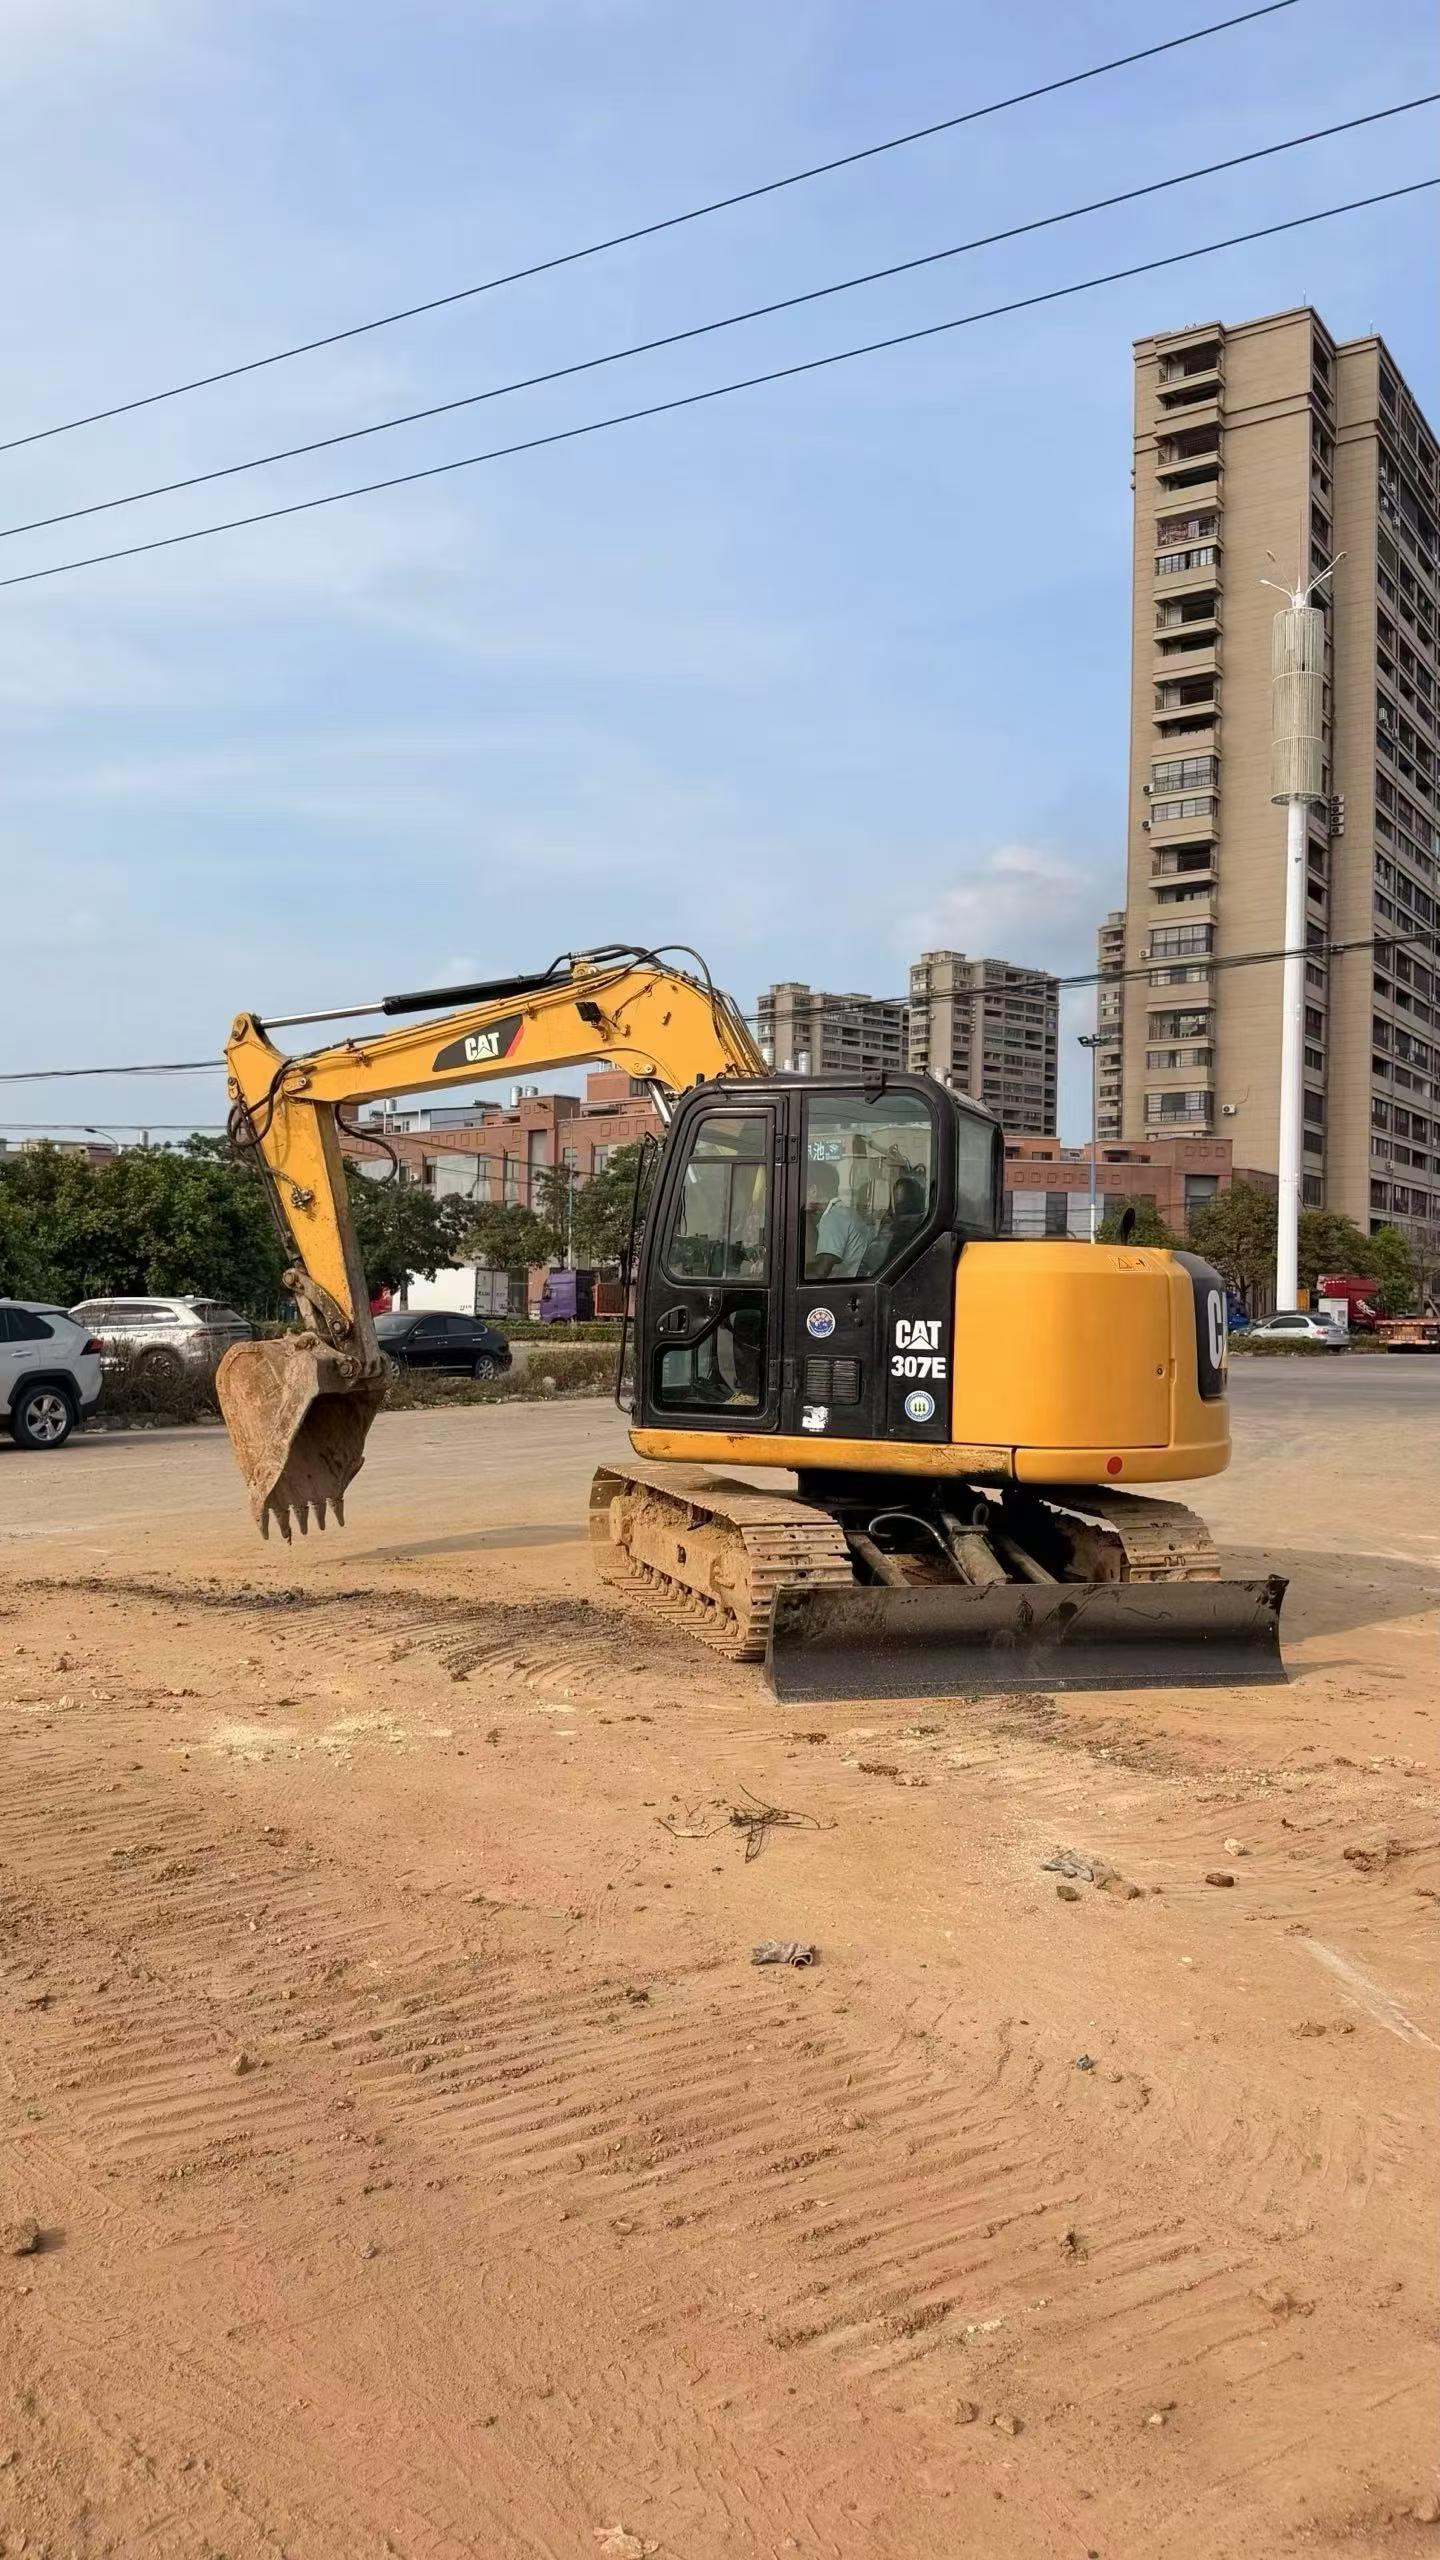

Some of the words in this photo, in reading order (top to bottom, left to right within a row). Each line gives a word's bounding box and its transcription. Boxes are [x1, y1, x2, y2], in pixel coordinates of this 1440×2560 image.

[465, 1032, 499, 1061] CAT
[896, 1320, 942, 1350] CAT
[891, 1355, 946, 1378] 307E
